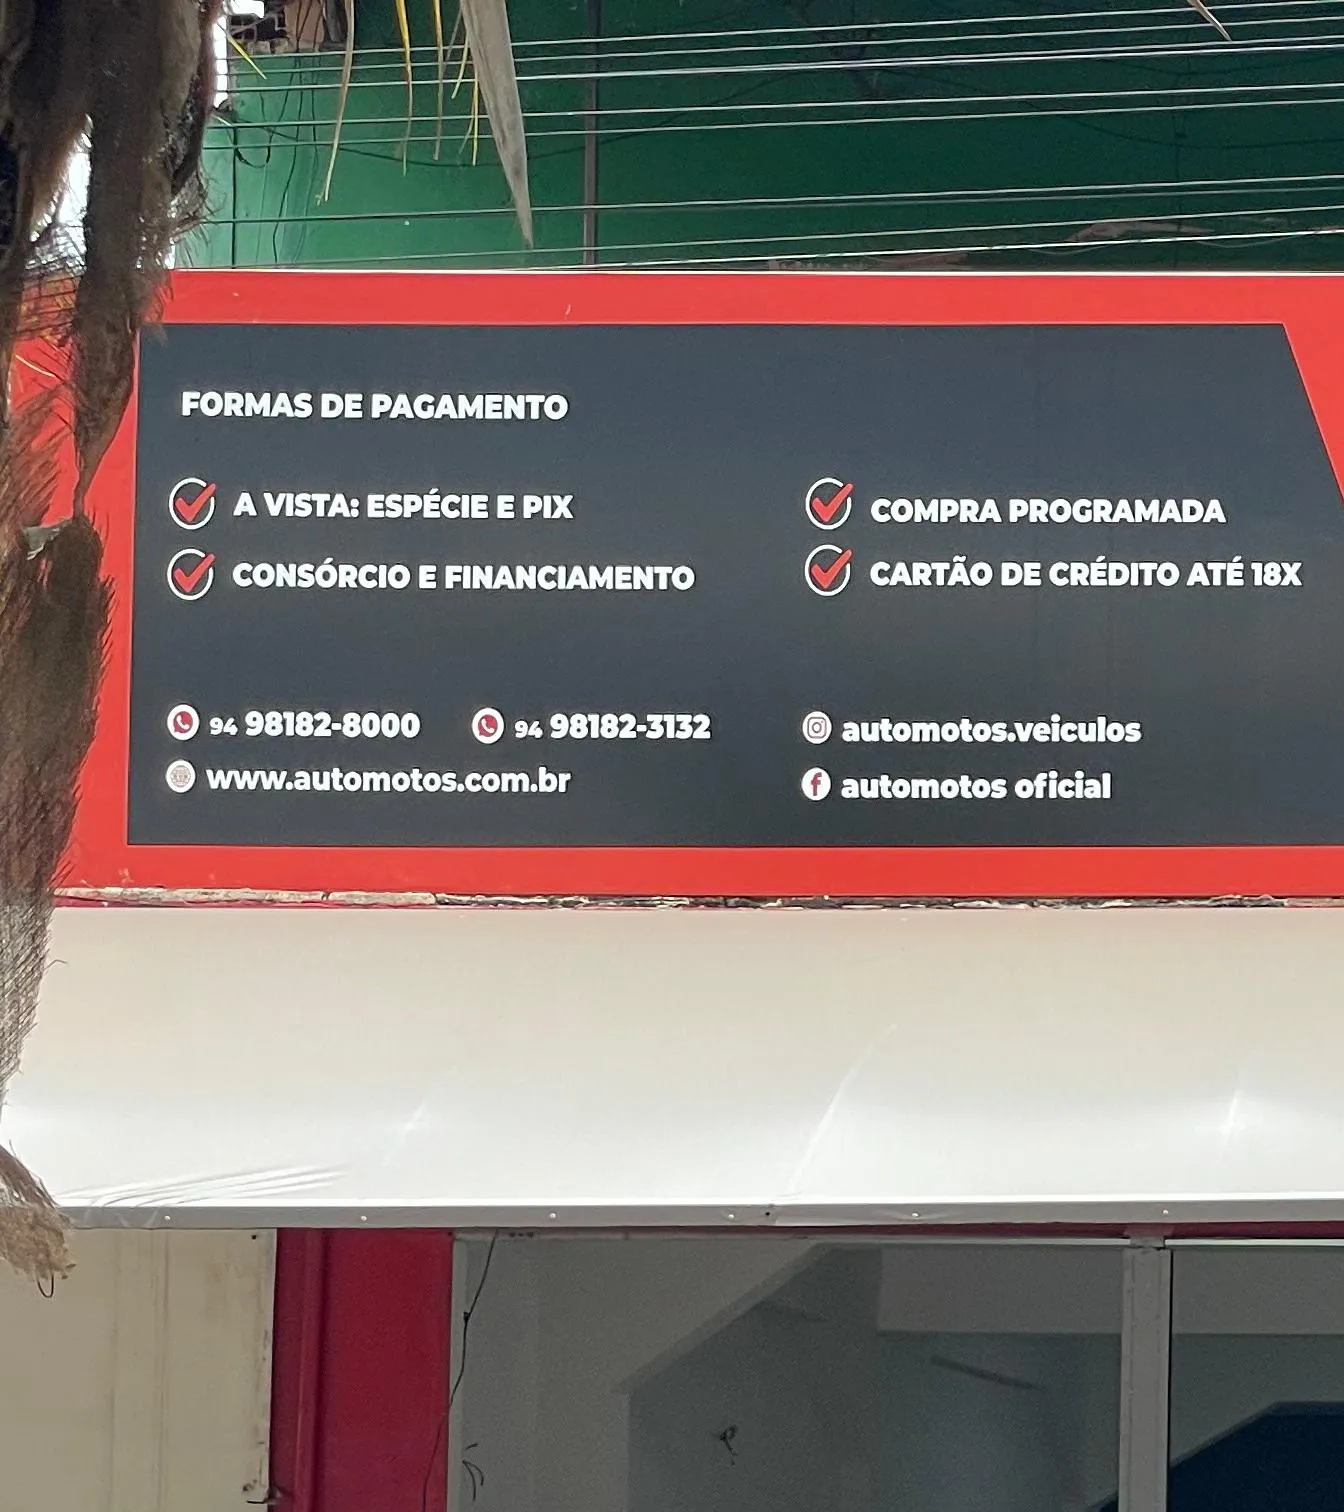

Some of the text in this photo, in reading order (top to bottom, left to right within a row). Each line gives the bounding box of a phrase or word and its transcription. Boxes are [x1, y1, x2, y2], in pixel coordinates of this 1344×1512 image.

[180, 390, 570, 421] FORMAS DE PAGAMENTO
[232, 486, 575, 520] A VISTA: ESPÉCIE E PIX
[869, 497, 1228, 524] COMPRA PROGRAMADA
[231, 556, 696, 592] CONSÓRCIO E FINANCIAMENTO
[869, 554, 1304, 588] CARTÃO DE CRÉDITO ATÉ 18X
[208, 709, 422, 740] 94 98182-8000
[513, 711, 712, 741] 94 98182-3132
[840, 712, 1143, 744] automotos.veiculos
[205, 765, 573, 794] www.automotos.com.br
[840, 773, 1008, 800] automotos
[1013, 769, 1112, 800] oficial
